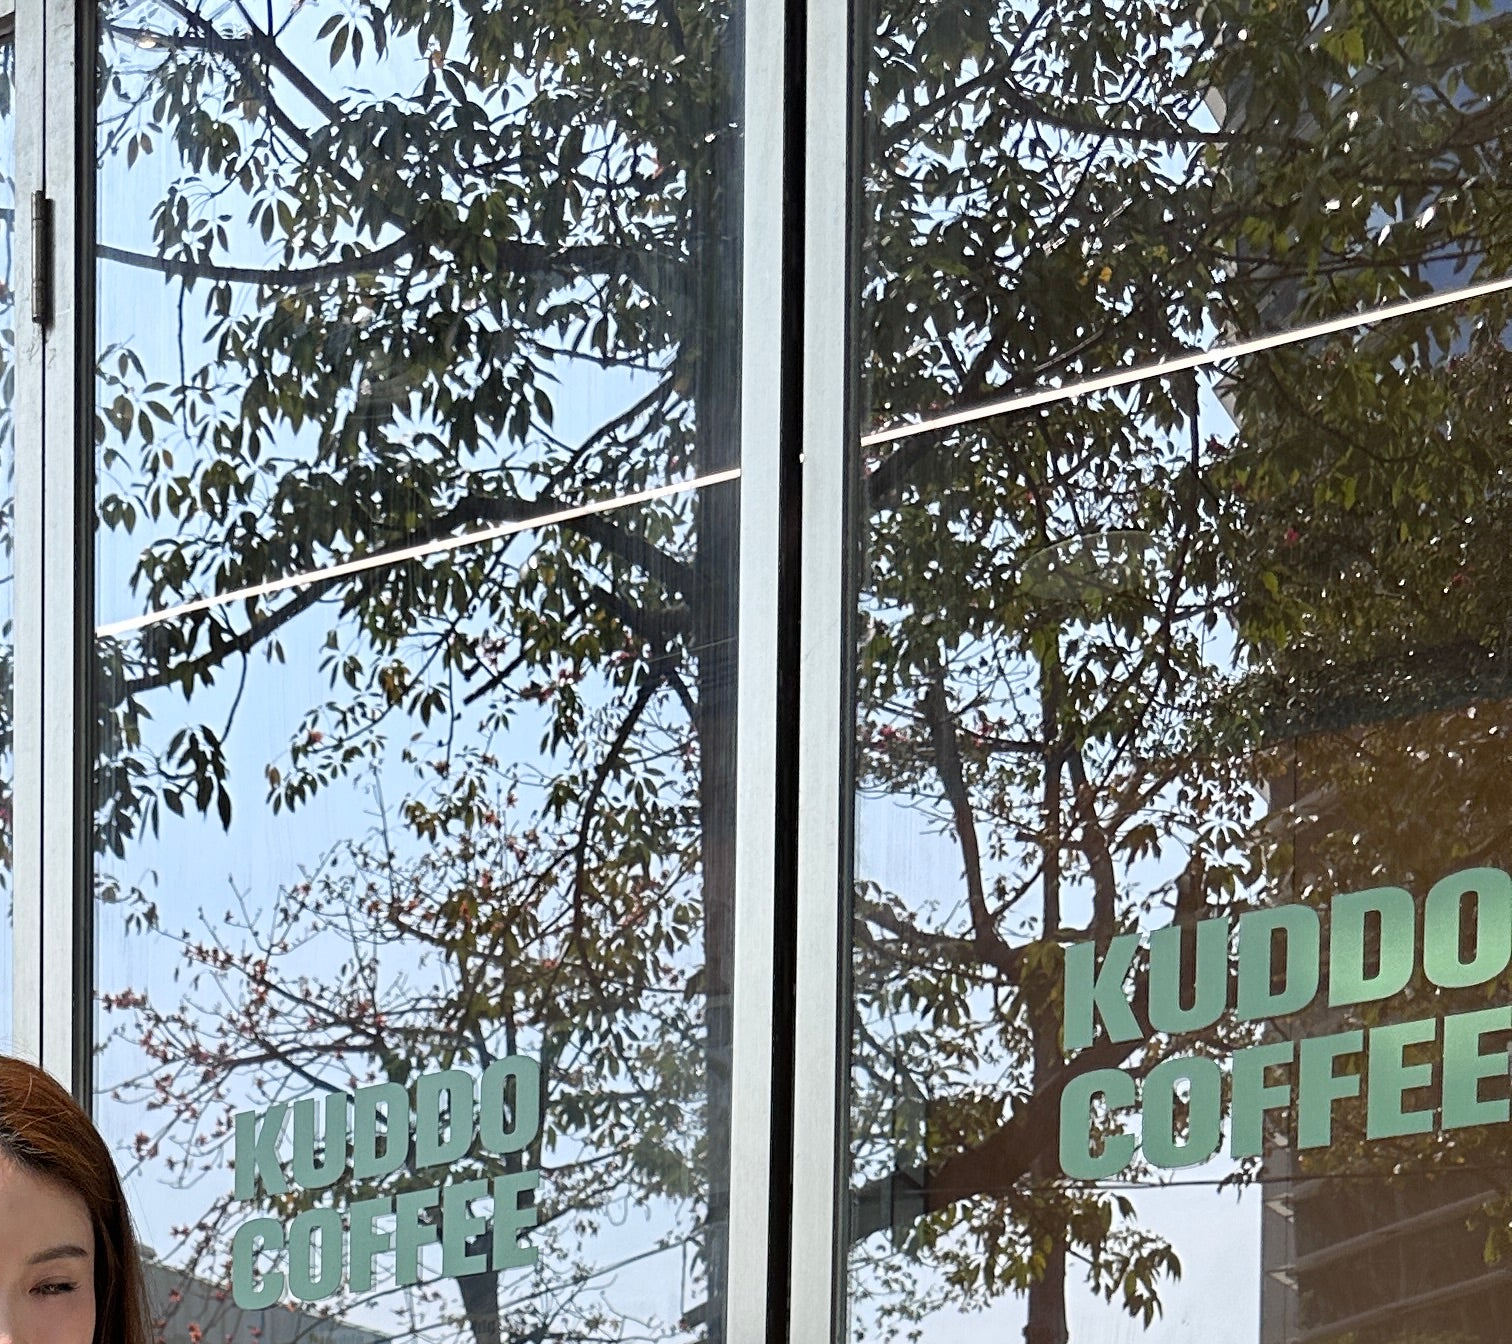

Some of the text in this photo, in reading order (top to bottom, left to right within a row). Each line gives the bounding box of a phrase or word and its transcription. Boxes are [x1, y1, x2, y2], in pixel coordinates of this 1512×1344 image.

[1063, 867, 1512, 1051] KUDDO
[234, 1054, 540, 1201] KUDDO
[1059, 1006, 1512, 1180] COFFEE
[231, 1170, 541, 1310] COFFEE
